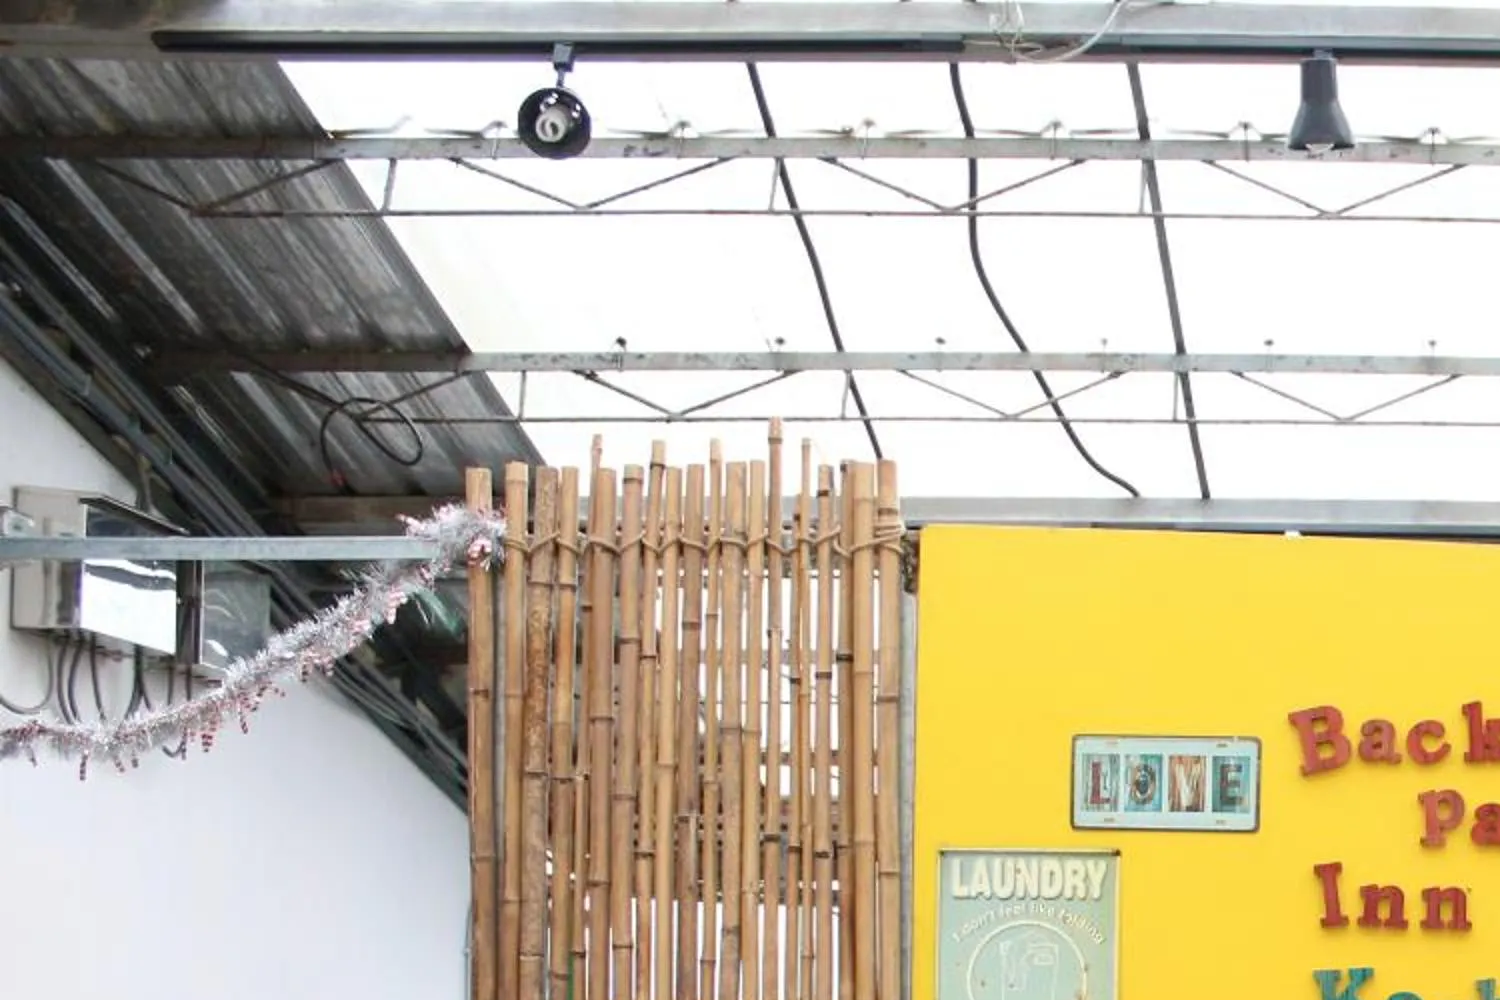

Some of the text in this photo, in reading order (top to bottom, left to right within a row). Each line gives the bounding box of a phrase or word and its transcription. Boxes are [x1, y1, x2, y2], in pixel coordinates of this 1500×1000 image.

[1088, 761, 1244, 808] LOVE
[952, 856, 1107, 901] LAUNDRY
[1313, 861, 1473, 932] Inn
